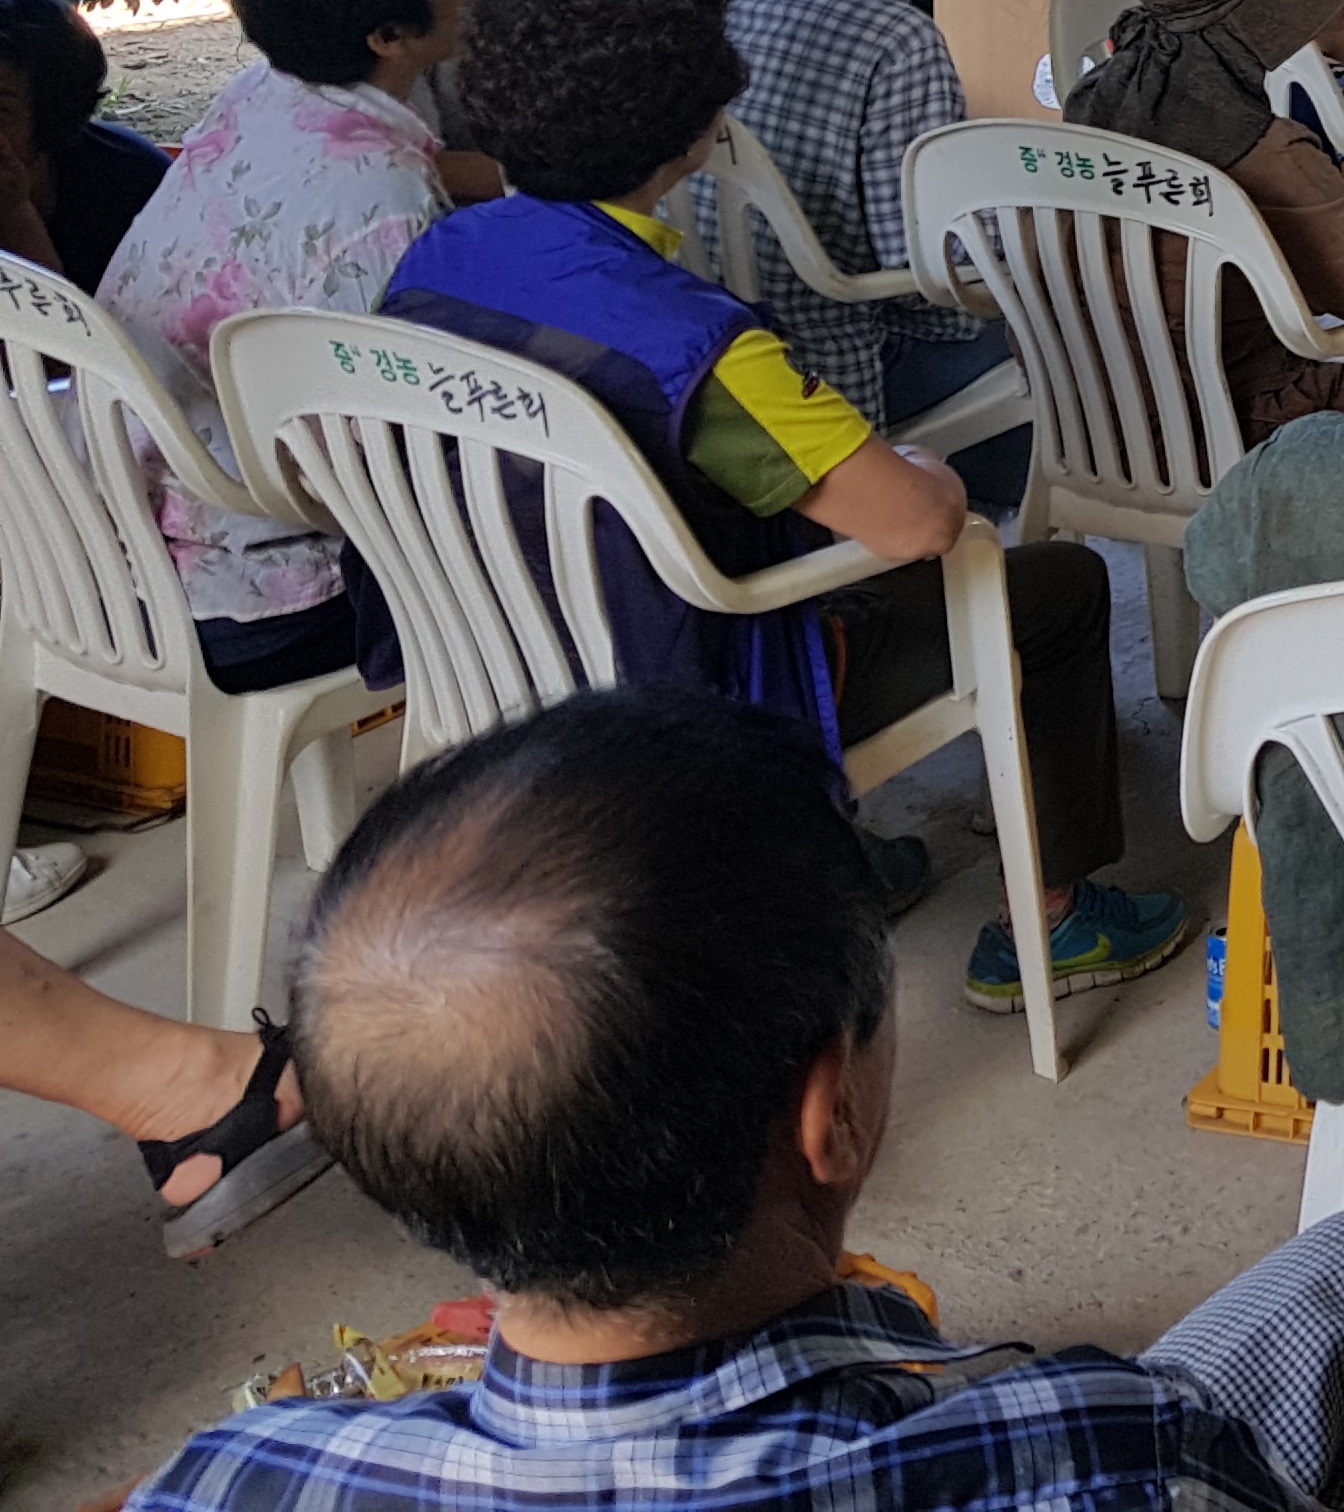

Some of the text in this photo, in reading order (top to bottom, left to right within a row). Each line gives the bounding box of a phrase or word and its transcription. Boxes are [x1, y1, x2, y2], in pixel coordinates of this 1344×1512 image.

[1054, 150, 1096, 181] 경농
[1101, 152, 1215, 218] 늘푸른회
[368, 348, 421, 386] 경농
[427, 361, 550, 439] 늘푸른회
